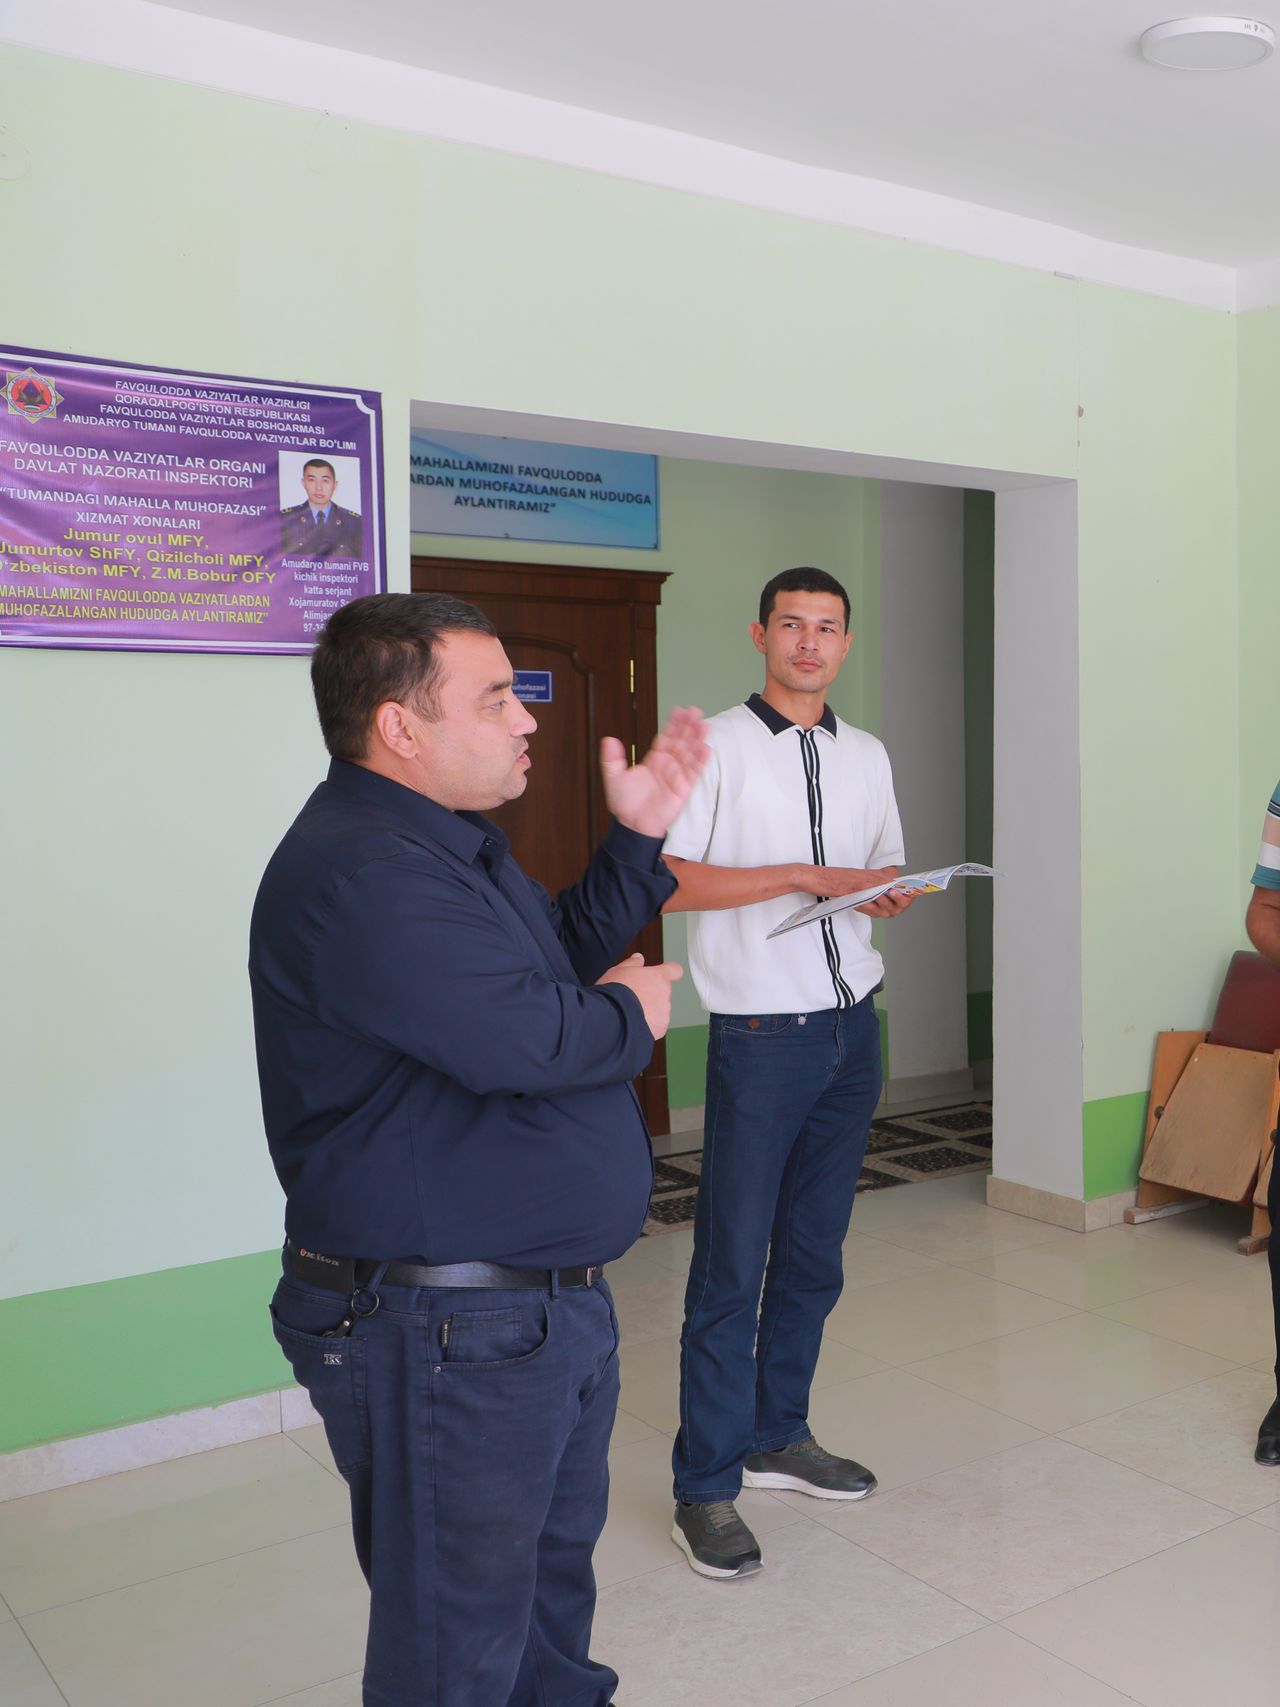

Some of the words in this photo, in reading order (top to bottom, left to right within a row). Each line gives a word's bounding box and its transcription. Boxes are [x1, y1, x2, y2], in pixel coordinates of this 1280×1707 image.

[115, 380, 192, 397] FAVQULODDA
[194, 389, 259, 404] VAZIYATLAR
[261, 396, 311, 410] VAZIRLIGI
[100, 404, 178, 421] FAVQULODDA
[179, 413, 245, 428] VAZIYATLAR
[247, 420, 325, 435] BOSHQARMASI
[234, 407, 311, 422] RESPUBLIKASI
[63, 414, 130, 429] AMUDARYO
[133, 420, 176, 433] TUMANI
[179, 425, 252, 441] FAVQULODDA
[254, 433, 317, 447] VAZIYATLAR
[0, 440, 109, 460] FAVQULODDA
[113, 450, 205, 468] VAZIYATLAR
[209, 459, 266, 474] ORGANI
[14, 458, 77, 474] DAVLAT
[82, 463, 160, 480] NAZORATI
[165, 471, 253, 488] INSPEKTORI
[518, 465, 602, 483] FAVQULODDA
[459, 478, 586, 499] MUHOFAZALANGAN
[590, 491, 652, 505] HUDUDGA
[104, 495, 170, 510] MAHALLA
[76, 511, 128, 525] XIZMAT
[132, 515, 200, 530] XONALARI
[63, 527, 121, 543] Jumur
[126, 533, 162, 544] ovul
[167, 533, 209, 549] MFY,
[89, 546, 141, 562] ShFY,
[146, 549, 224, 565] Qizilcholi
[228, 554, 269, 570] MFY,
[281, 558, 323, 571] Amudaryo
[324, 560, 351, 571] tumani
[352, 561, 369, 571] FVB
[0, 559, 97, 576] ‘zbekiston
[103, 564, 146, 580] MFY,
[151, 566, 238, 583] Z.M.Bobur
[241, 571, 276, 584] OFY
[294, 572, 318, 582] kichik
[319, 573, 359, 584] inspektori
[95, 588, 176, 604] FAVQULODDA
[179, 591, 270, 607] VAZIYATLARDAN
[303, 585, 323, 595] katta
[324, 587, 352, 597] serjant
[288, 597, 339, 608] Xojamuratov
[120, 607, 179, 621] HUDUDGA
